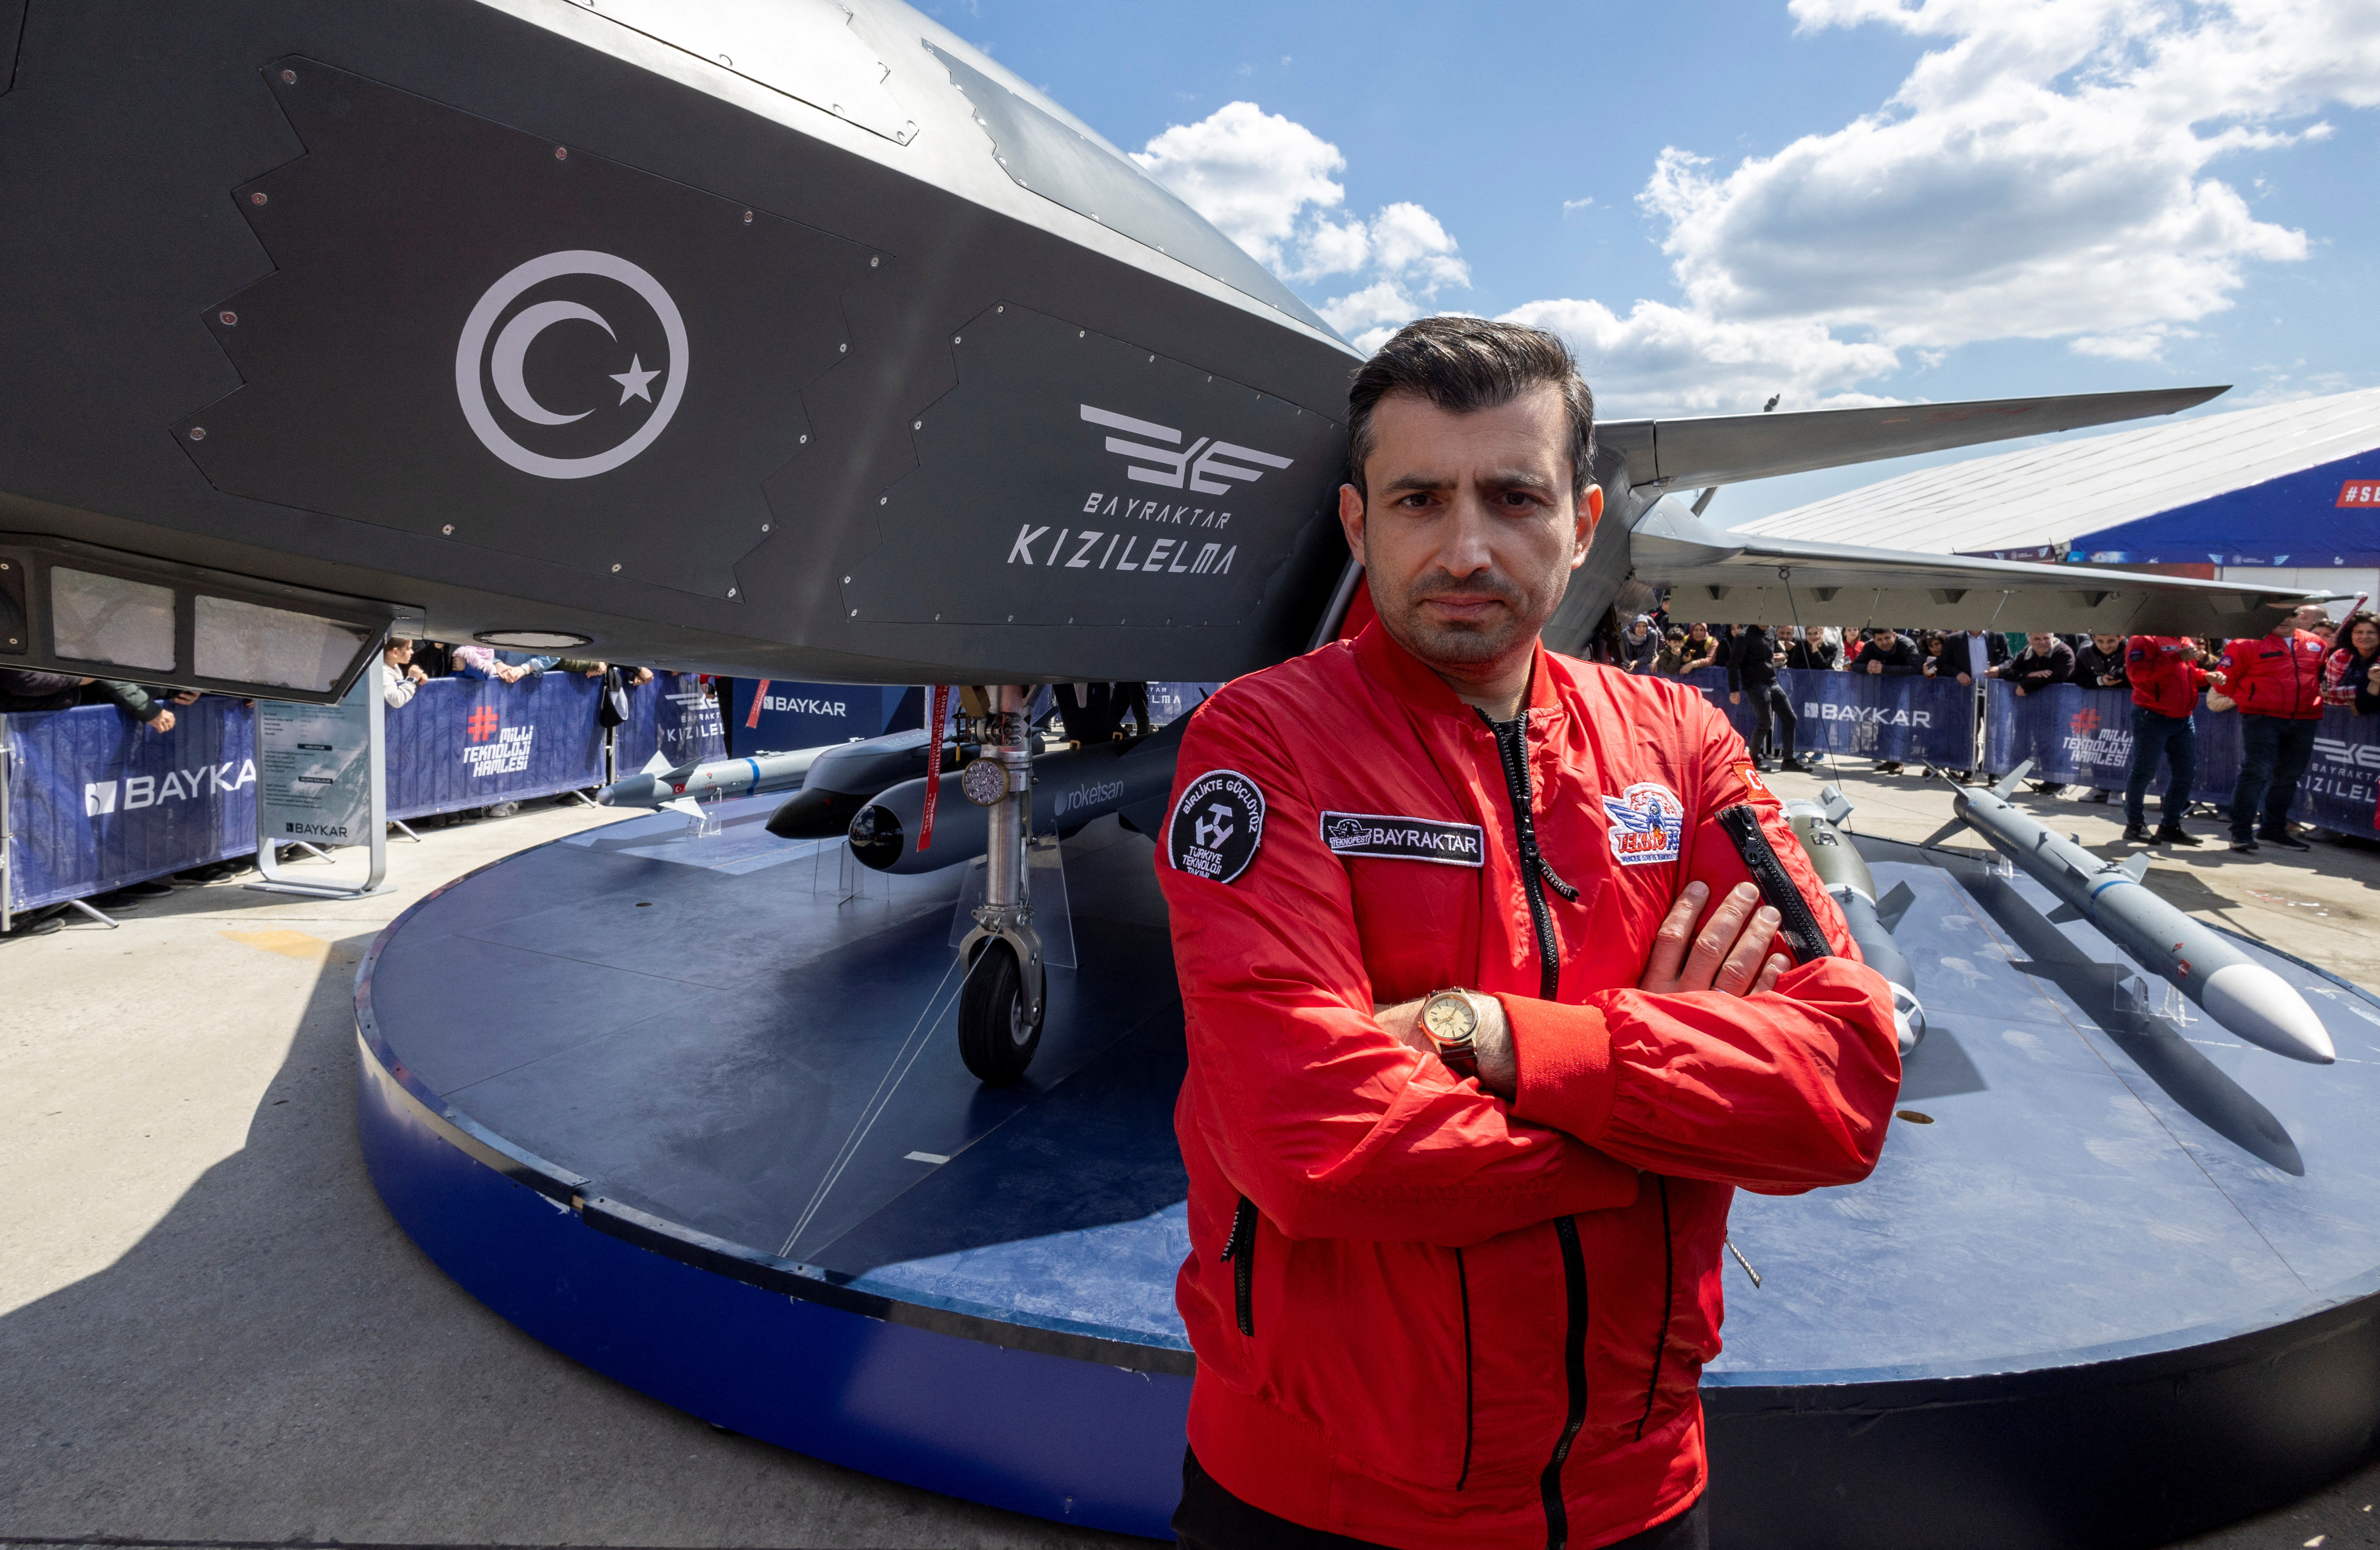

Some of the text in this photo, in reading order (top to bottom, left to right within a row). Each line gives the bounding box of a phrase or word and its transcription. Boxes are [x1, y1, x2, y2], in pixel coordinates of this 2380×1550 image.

[1083, 492, 1231, 529] BAYRAKTAR
[1007, 524, 1237, 575] KIZILELMA
[681, 712, 720, 723] BAYRAKT
[776, 696, 846, 717] BAYKAR
[939, 695, 947, 721] ÖNCE
[1821, 703, 1931, 729] BAYKAR
[667, 722, 725, 742] KIZILEL
[124, 759, 256, 810] BAYKA
[2312, 763, 2380, 782] BAYRAKTA
[1067, 780, 1123, 810] roketsan
[2297, 775, 2376, 803] IZILEL
[295, 823, 347, 838] BAYKAR
[1332, 829, 1478, 853] TEKNOFEST BAYRAKTAR
[1222, 1211, 1239, 1256] teknofest
